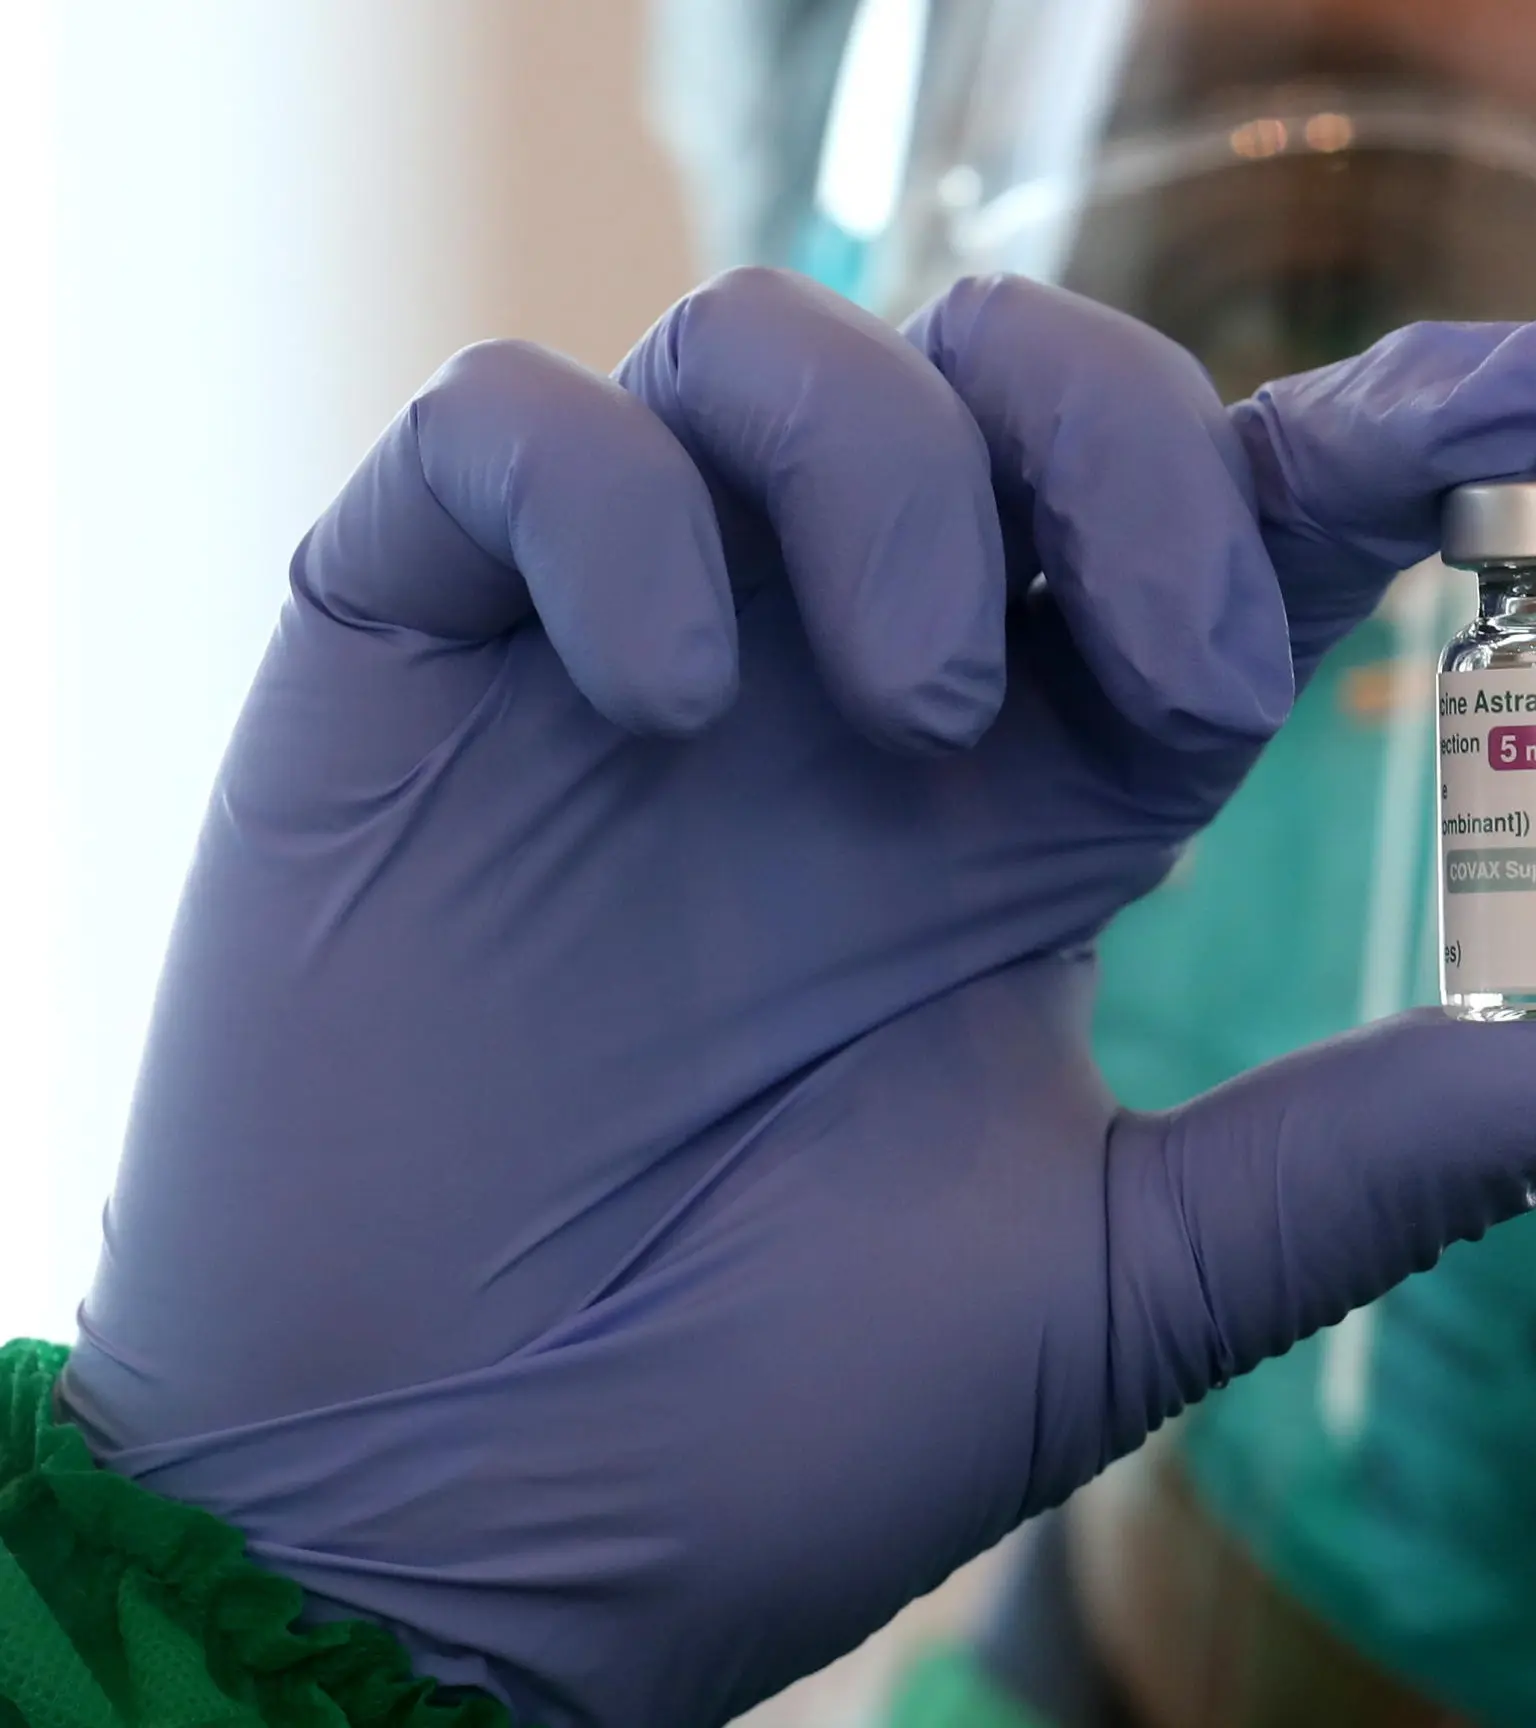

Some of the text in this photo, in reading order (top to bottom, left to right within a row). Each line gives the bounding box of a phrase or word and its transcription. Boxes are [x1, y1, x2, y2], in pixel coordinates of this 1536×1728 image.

[1500, 735, 1517, 763] 5
[1442, 811, 1530, 836] ombinant])
[1450, 861, 1500, 881] COVAX
